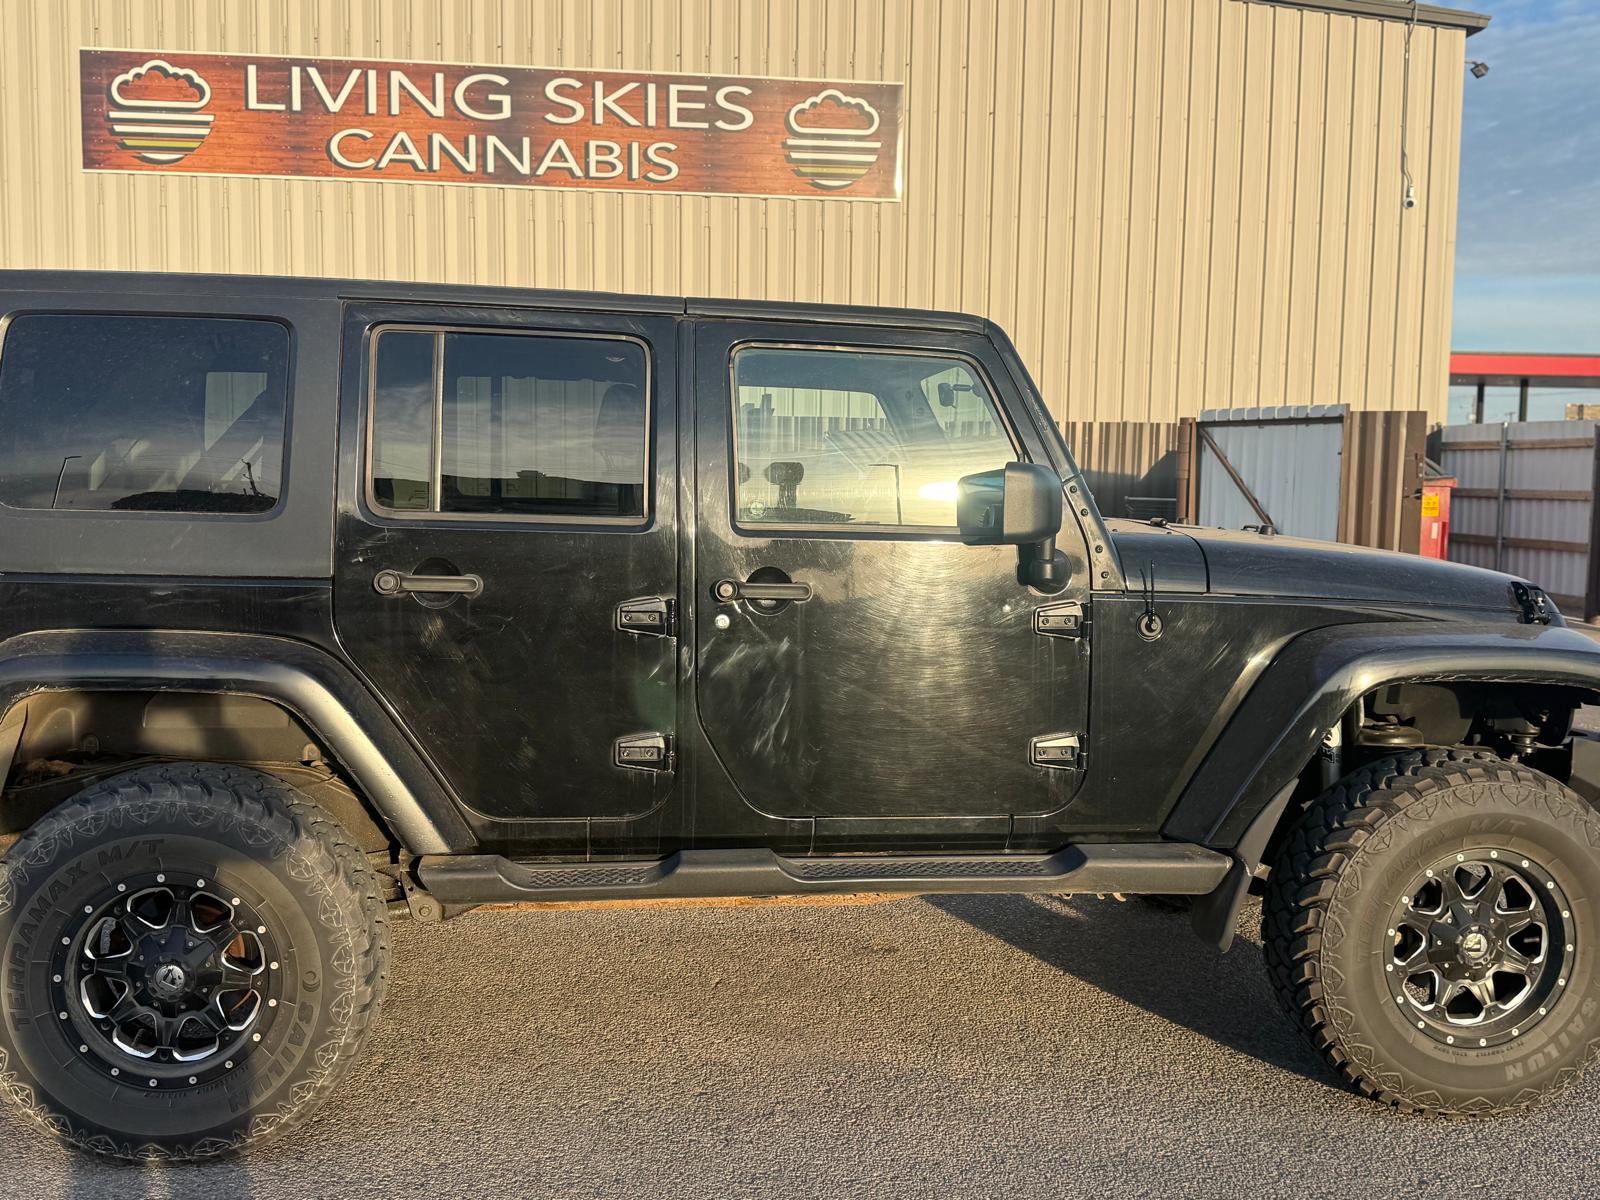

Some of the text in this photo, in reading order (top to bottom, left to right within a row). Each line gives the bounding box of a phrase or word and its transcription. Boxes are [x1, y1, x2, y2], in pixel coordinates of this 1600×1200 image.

[245, 63, 755, 132] LIVING SKIES
[328, 127, 680, 182] CANNABIS
[7, 838, 165, 1032] TERRAMAX M/T
[227, 1001, 315, 1113] SAILUN
[1505, 997, 1598, 1082] SAILUN
